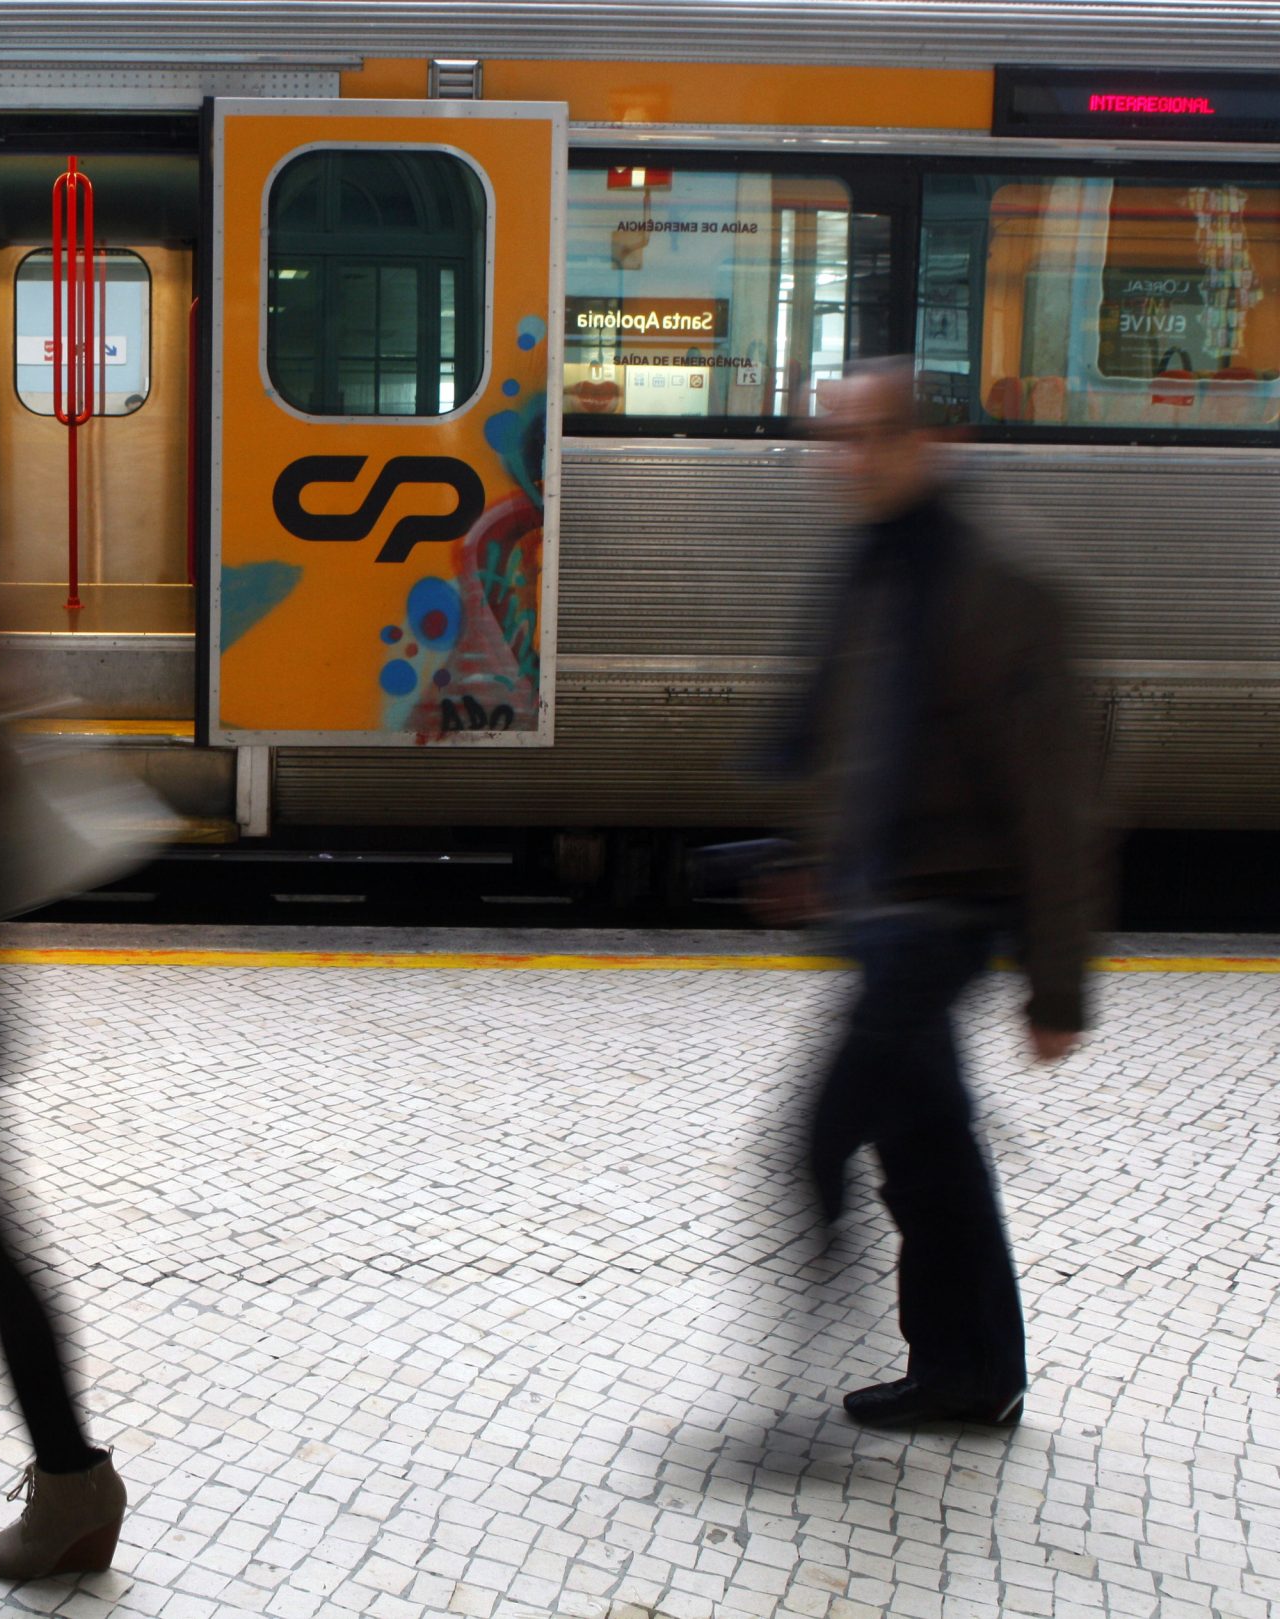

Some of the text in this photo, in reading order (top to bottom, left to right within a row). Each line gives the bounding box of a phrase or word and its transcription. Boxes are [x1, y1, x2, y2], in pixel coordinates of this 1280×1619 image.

[1089, 94, 1215, 114] INTERREGIONAL
[613, 353, 753, 368] SAÍDA DE EMERGÊNCIA
[272, 455, 486, 564] CP
